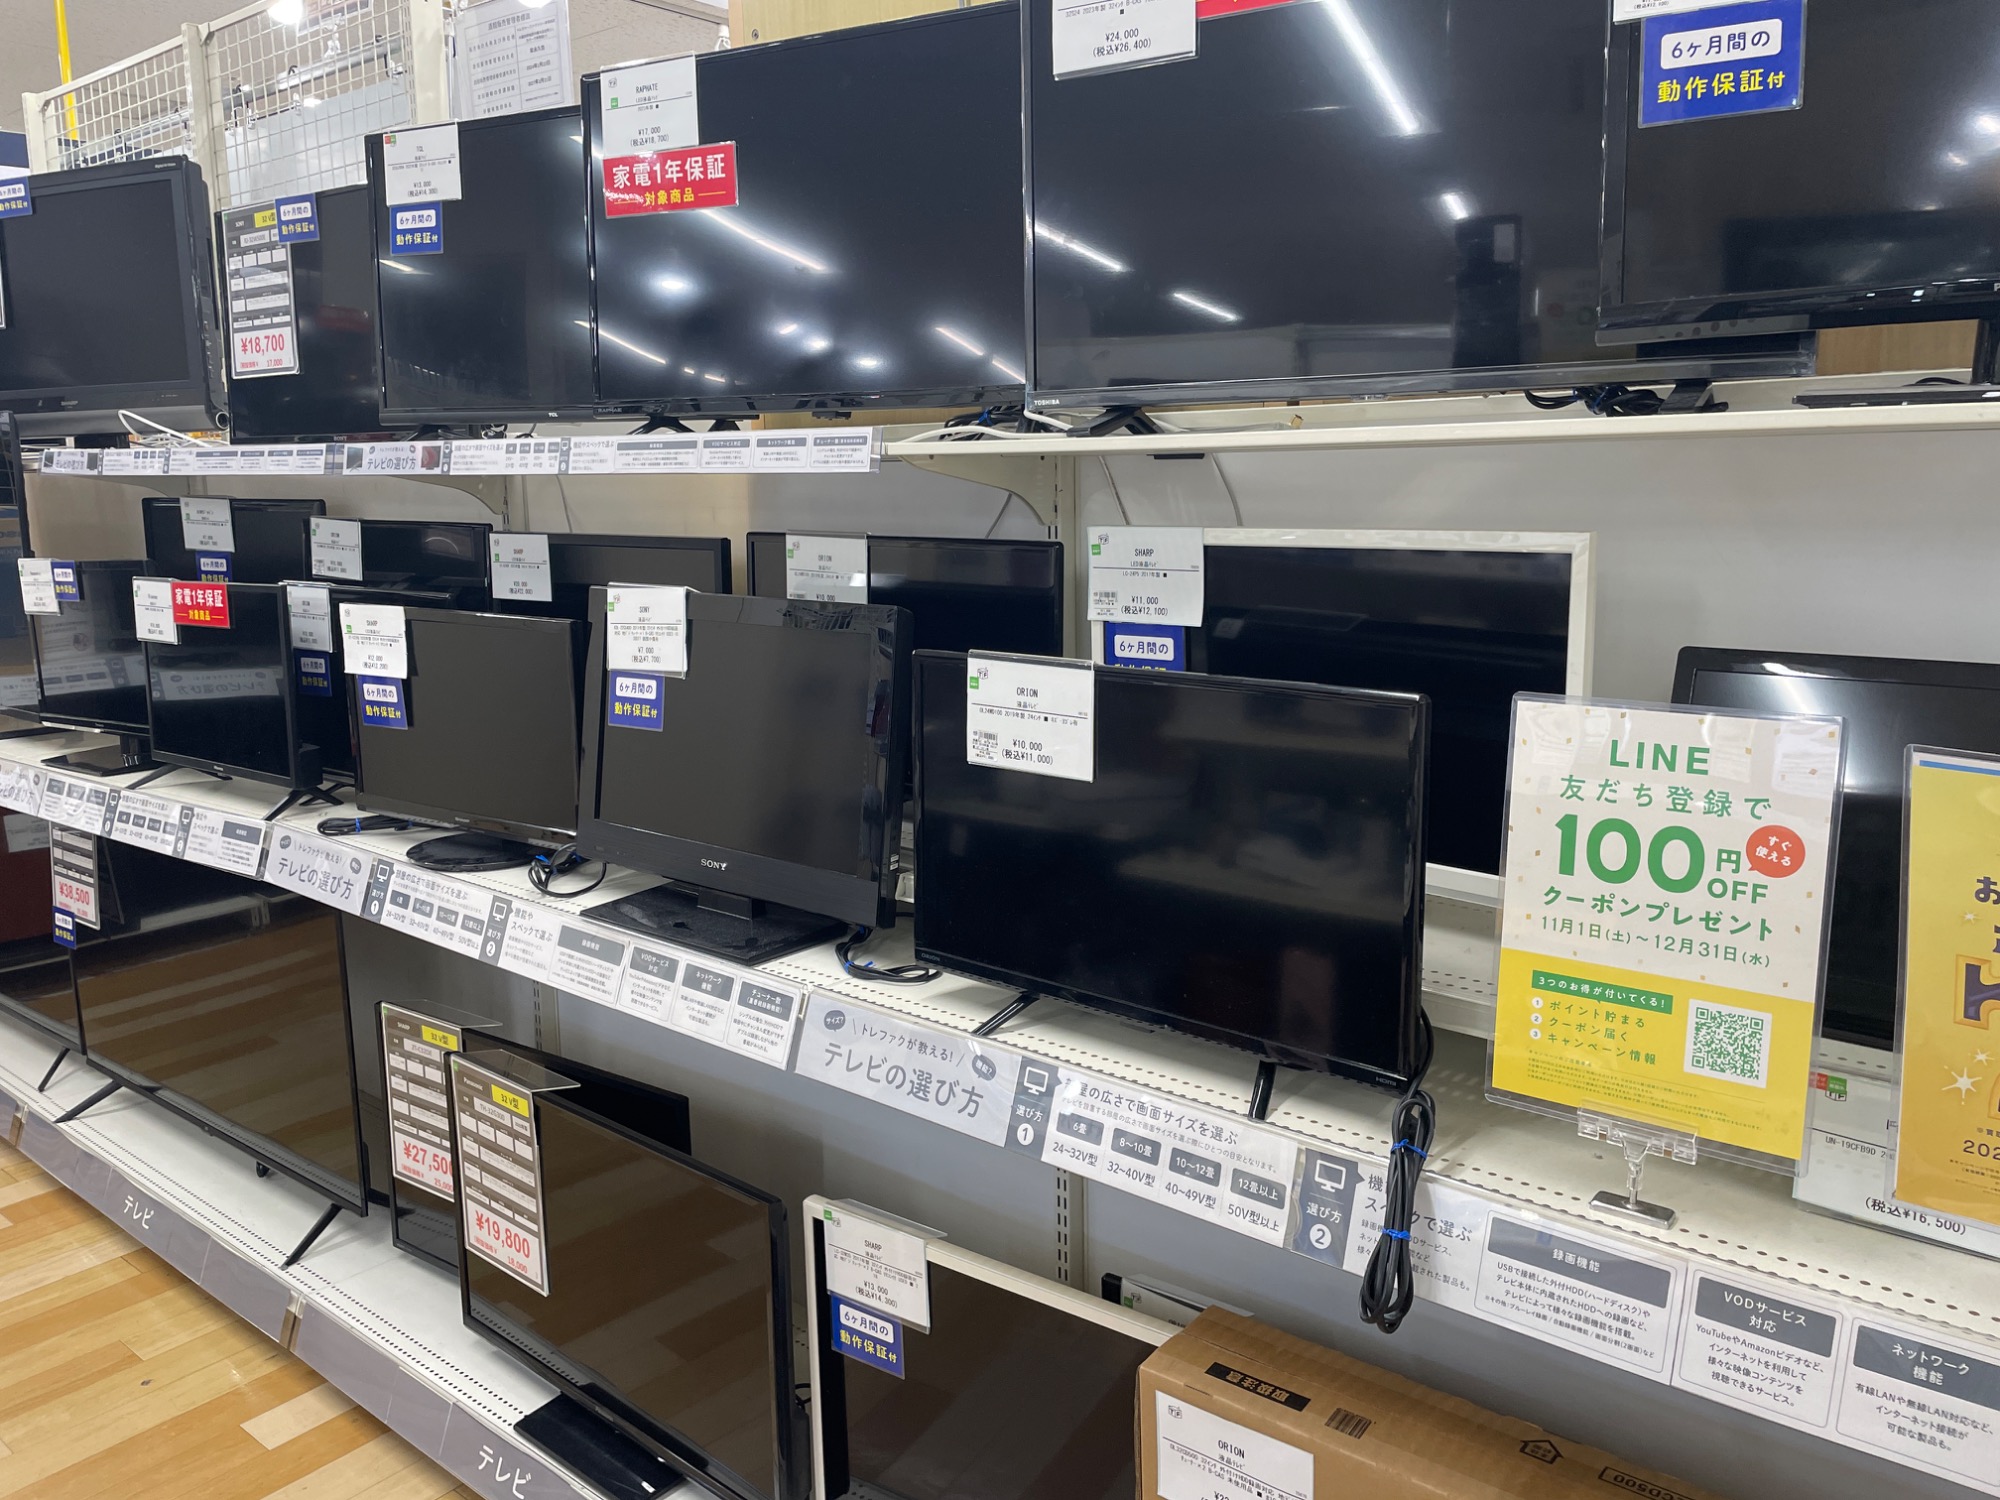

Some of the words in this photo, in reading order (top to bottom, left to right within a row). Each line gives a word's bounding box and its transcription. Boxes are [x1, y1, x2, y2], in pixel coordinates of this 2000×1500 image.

[1105, 28, 1139, 43] ¥24,000
[1671, 30, 1770, 59] 6ヶ月間の
[1093, 38, 1152, 58] (税込¥26,400)
[1657, 69, 1786, 103] 動作保証付
[630, 134, 670, 147] (税込¥18,700)
[638, 126, 661, 136] ¥17,000
[613, 154, 726, 189] 家電1年保証
[645, 187, 694, 206] 対象商品
[282, 206, 309, 218] 6ヶ月間の
[400, 214, 432, 224] 6ヶ月間の
[282, 222, 315, 235] 動作保証付
[396, 232, 438, 245] 動作保証付
[241, 333, 284, 356] ¥18,700
[367, 457, 417, 470] テレビの選び方
[1134, 548, 1154, 557] SHARP
[175, 588, 224, 608] 家電1年保証
[1132, 596, 1158, 604] ¥11,000
[188, 610, 212, 621] 対象商品
[639, 606, 650, 614] SONY
[1121, 606, 1168, 616] (税込¥12,100)
[638, 646, 654, 654] ¥7,000
[1120, 641, 1168, 655] 6ヶ月間の
[631, 655, 661, 664] (税込¥7,700)
[366, 687, 395, 699] 6ヶ月間の
[619, 682, 654, 695] 6ヶ月間の
[1016, 687, 1038, 698] ORION
[365, 704, 401, 719] 動作保証付
[614, 702, 658, 719] 動作保証付
[1012, 739, 1043, 752] ¥10,000
[1002, 748, 1054, 765] (税込¥11,000)
[1609, 740, 1710, 776] LINE
[1560, 774, 1771, 820] 友だち登録で
[1768, 835, 1793, 851] すぐ
[700, 858, 728, 870] SONY
[1755, 845, 1792, 867] 使える
[278, 857, 354, 900] テレビの選び方
[59, 882, 90, 906] ¥38,500
[1707, 878, 1768, 904] OFF
[1544, 886, 1773, 942] クーポンプレゼント
[511, 921, 554, 942] スペックで選ぶ
[696, 971, 722, 984] ネットワーク
[1538, 976, 1666, 1008] 3つのお得が付いてくる!
[1550, 1000, 1646, 1029] ポイント貯まる
[1548, 1016, 1628, 1044] クーポン届く
[862, 1023, 954, 1063] トレファクが教える!
[1547, 1032, 1658, 1066] キャンペーン情報
[464, 1076, 484, 1091] Panasonic
[825, 1042, 984, 1118] テレビの選び方
[500, 1093, 508, 1104] 32
[508, 1096, 520, 1110] V型
[1015, 1104, 1044, 1122] 選び方
[1065, 1078, 1238, 1146] 屋の広さで画面サイズを選ぶ
[1072, 1121, 1088, 1136] 6畳
[1238, 1178, 1279, 1201] 12畳以上
[123, 1194, 155, 1230] テレビ
[1228, 1203, 1280, 1233] 50V型以上
[1306, 1202, 1343, 1224] 選び方
[1864, 1196, 1967, 1236] (税込¥16,500)
[475, 1210, 530, 1259] ¥19,800
[864, 1240, 882, 1252] SHARP
[508, 1256, 528, 1274] 18,000
[1552, 1248, 1600, 1273] 録画機能
[856, 1287, 898, 1308] (税込¥14,300)
[864, 1280, 889, 1296] ¥13,000
[1724, 1290, 1808, 1327] VODサービス
[844, 1312, 889, 1336] 6ヶ月間の
[1749, 1314, 1777, 1334] 対応
[840, 1330, 898, 1364] 動作保証付
[1696, 1323, 1824, 1373] YouTubeやAmazonビデオなど、
[1708, 1342, 1808, 1382] インターネットを利用して
[1892, 1342, 1970, 1376] ネットワーク
[1707, 1356, 1804, 1395] 様々な映像コンテンツを
[1913, 1366, 1944, 1386] 機能
[1710, 1371, 1795, 1408] 視聴できるサービス。
[1855, 1382, 1994, 1435] 有線LANや無線LAN対応など、
[1876, 1405, 1968, 1440] インターネット接続が
[1886, 1422, 1952, 1452] 可能な製品も。
[1218, 1439, 1245, 1459] ORION
[478, 1444, 532, 1500] テレビ
